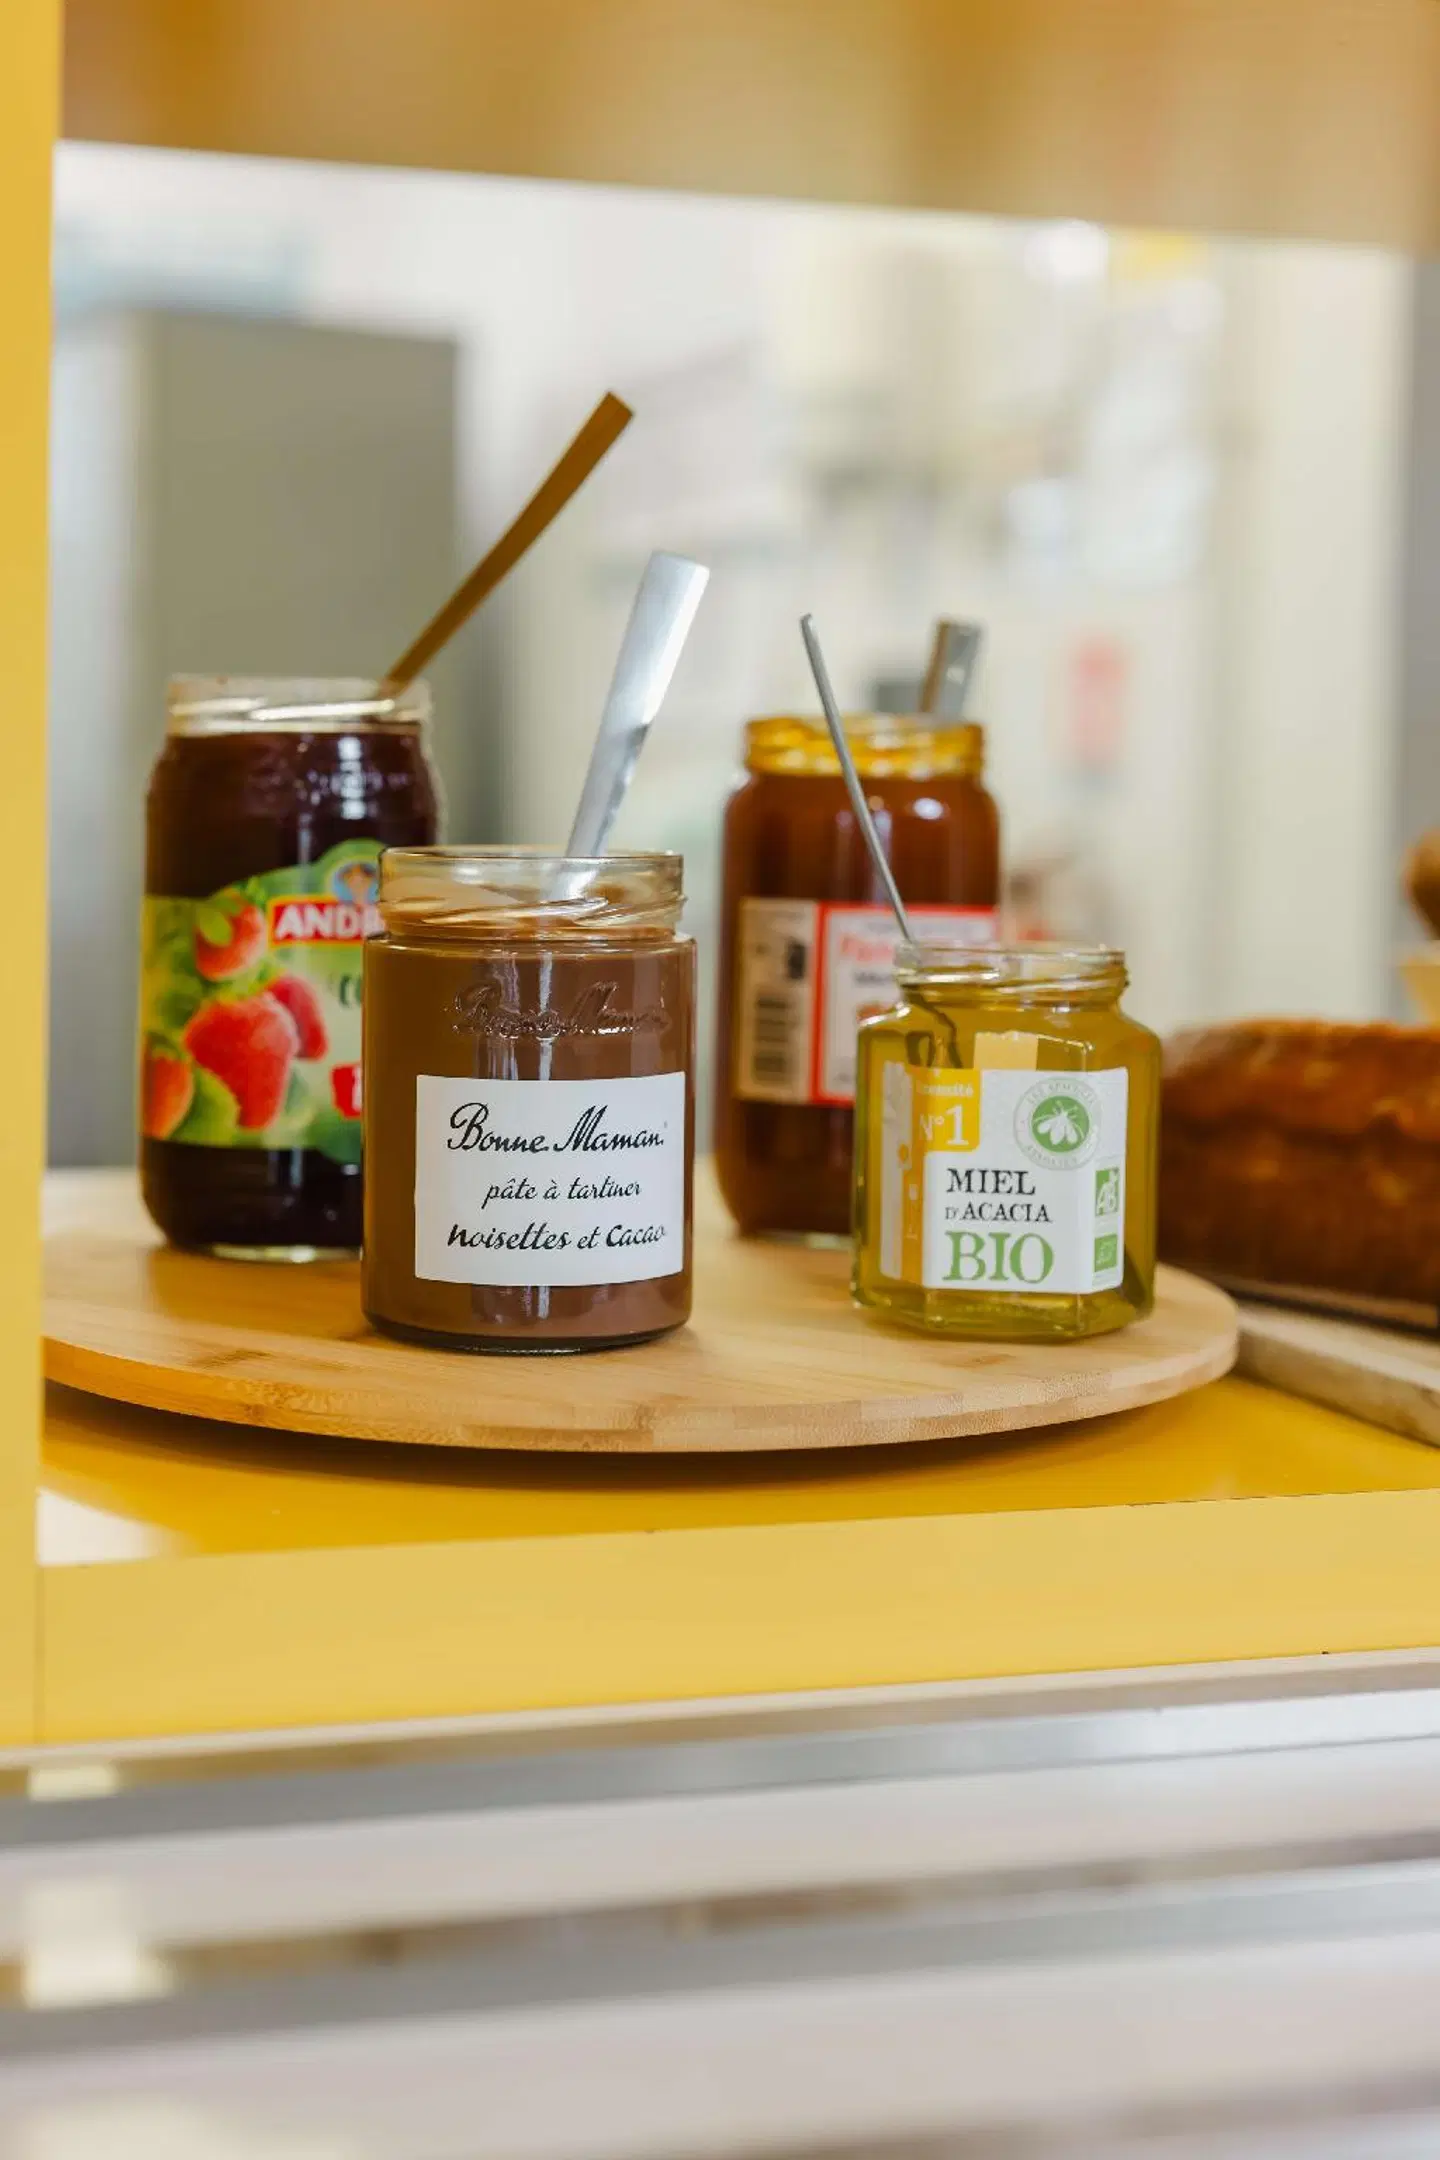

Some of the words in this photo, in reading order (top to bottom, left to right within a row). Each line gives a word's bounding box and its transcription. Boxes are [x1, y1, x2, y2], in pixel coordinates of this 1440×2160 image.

[447, 1102, 549, 1153] Bonne
[481, 1175, 537, 1209] pâte
[543, 1180, 560, 1200] à
[568, 1175, 641, 1200] tartiner
[946, 1168, 1036, 1195] MIEL
[577, 1227, 600, 1249] et
[942, 1231, 1055, 1284] BIO
